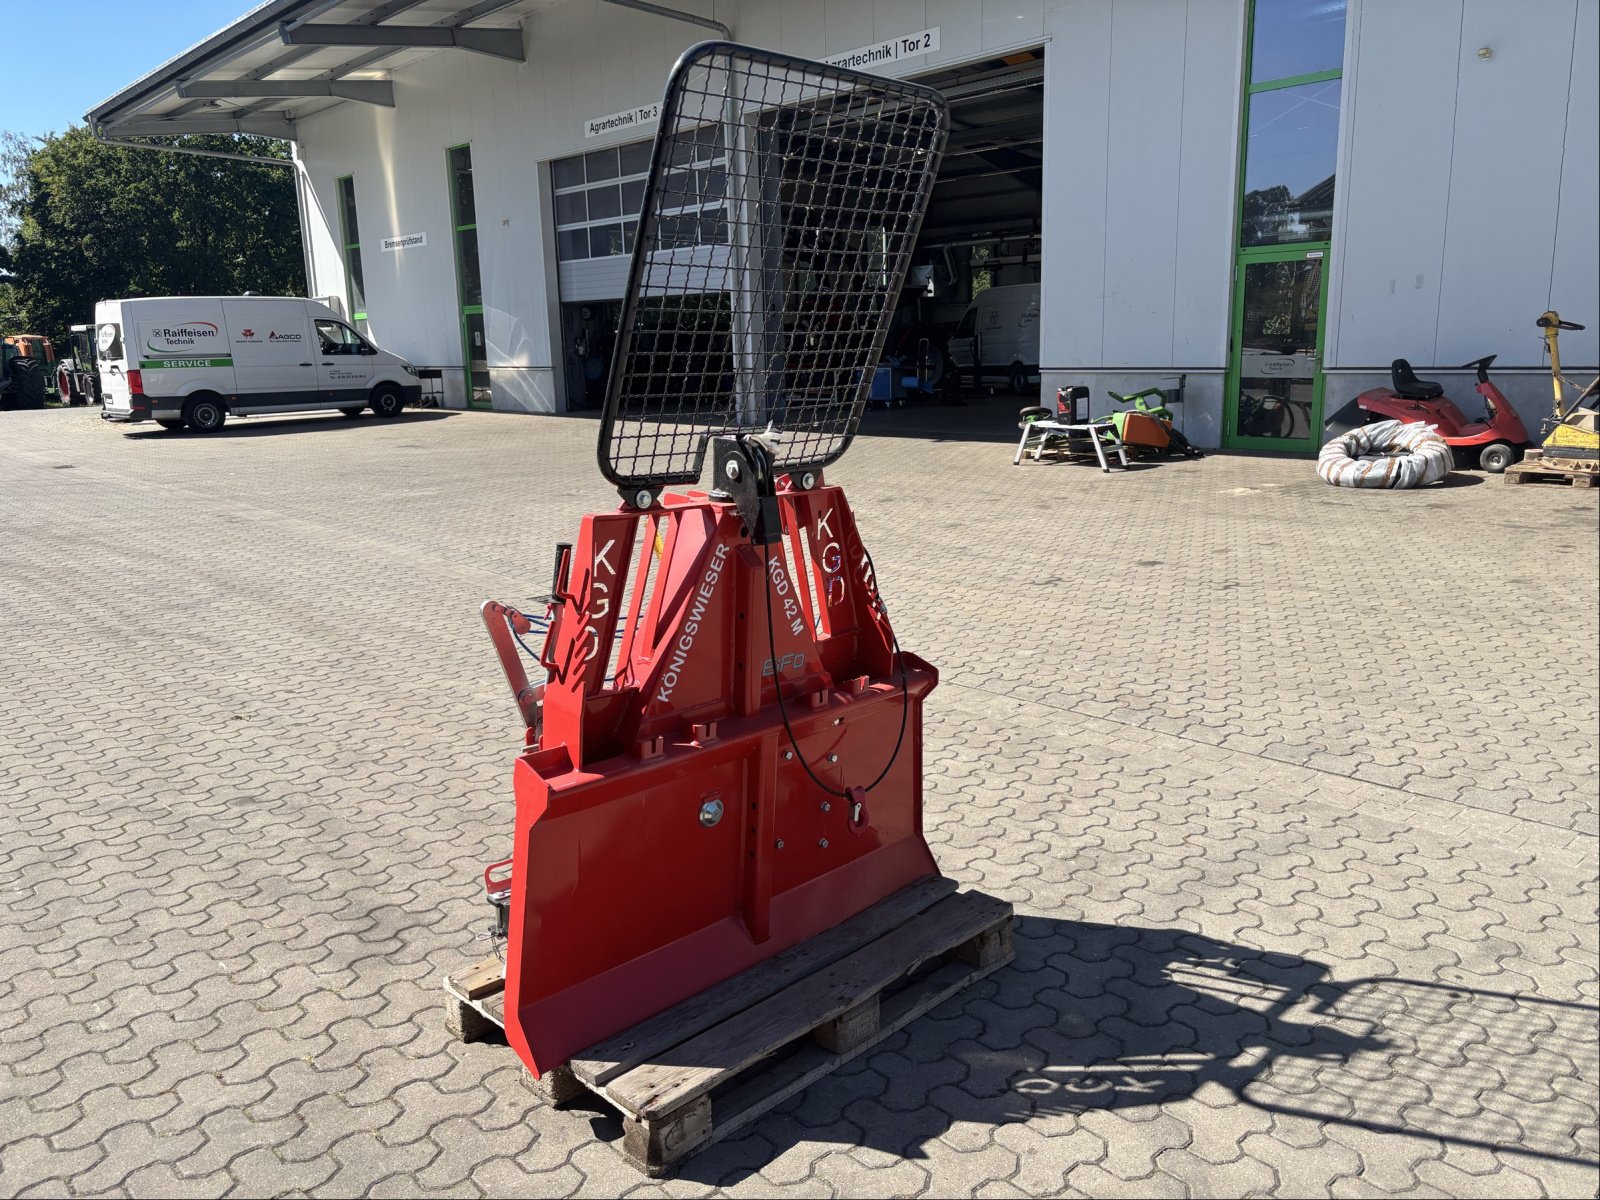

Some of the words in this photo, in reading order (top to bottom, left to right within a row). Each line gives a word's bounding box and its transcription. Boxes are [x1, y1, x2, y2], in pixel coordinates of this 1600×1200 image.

[825, 44, 892, 69] rartechnik
[902, 38, 921, 53] Tor
[924, 33, 931, 48] 2
[590, 112, 634, 134] Agrartechnik
[639, 109, 652, 121] Tor
[653, 106, 658, 117] 3
[163, 328, 215, 338] Raiffeisen
[163, 359, 212, 368] SERVICE
[768, 555, 789, 596] KGD
[783, 598, 798, 620] 42
[656, 542, 731, 703] KÖNIGSWIESER
[790, 617, 804, 636] M
